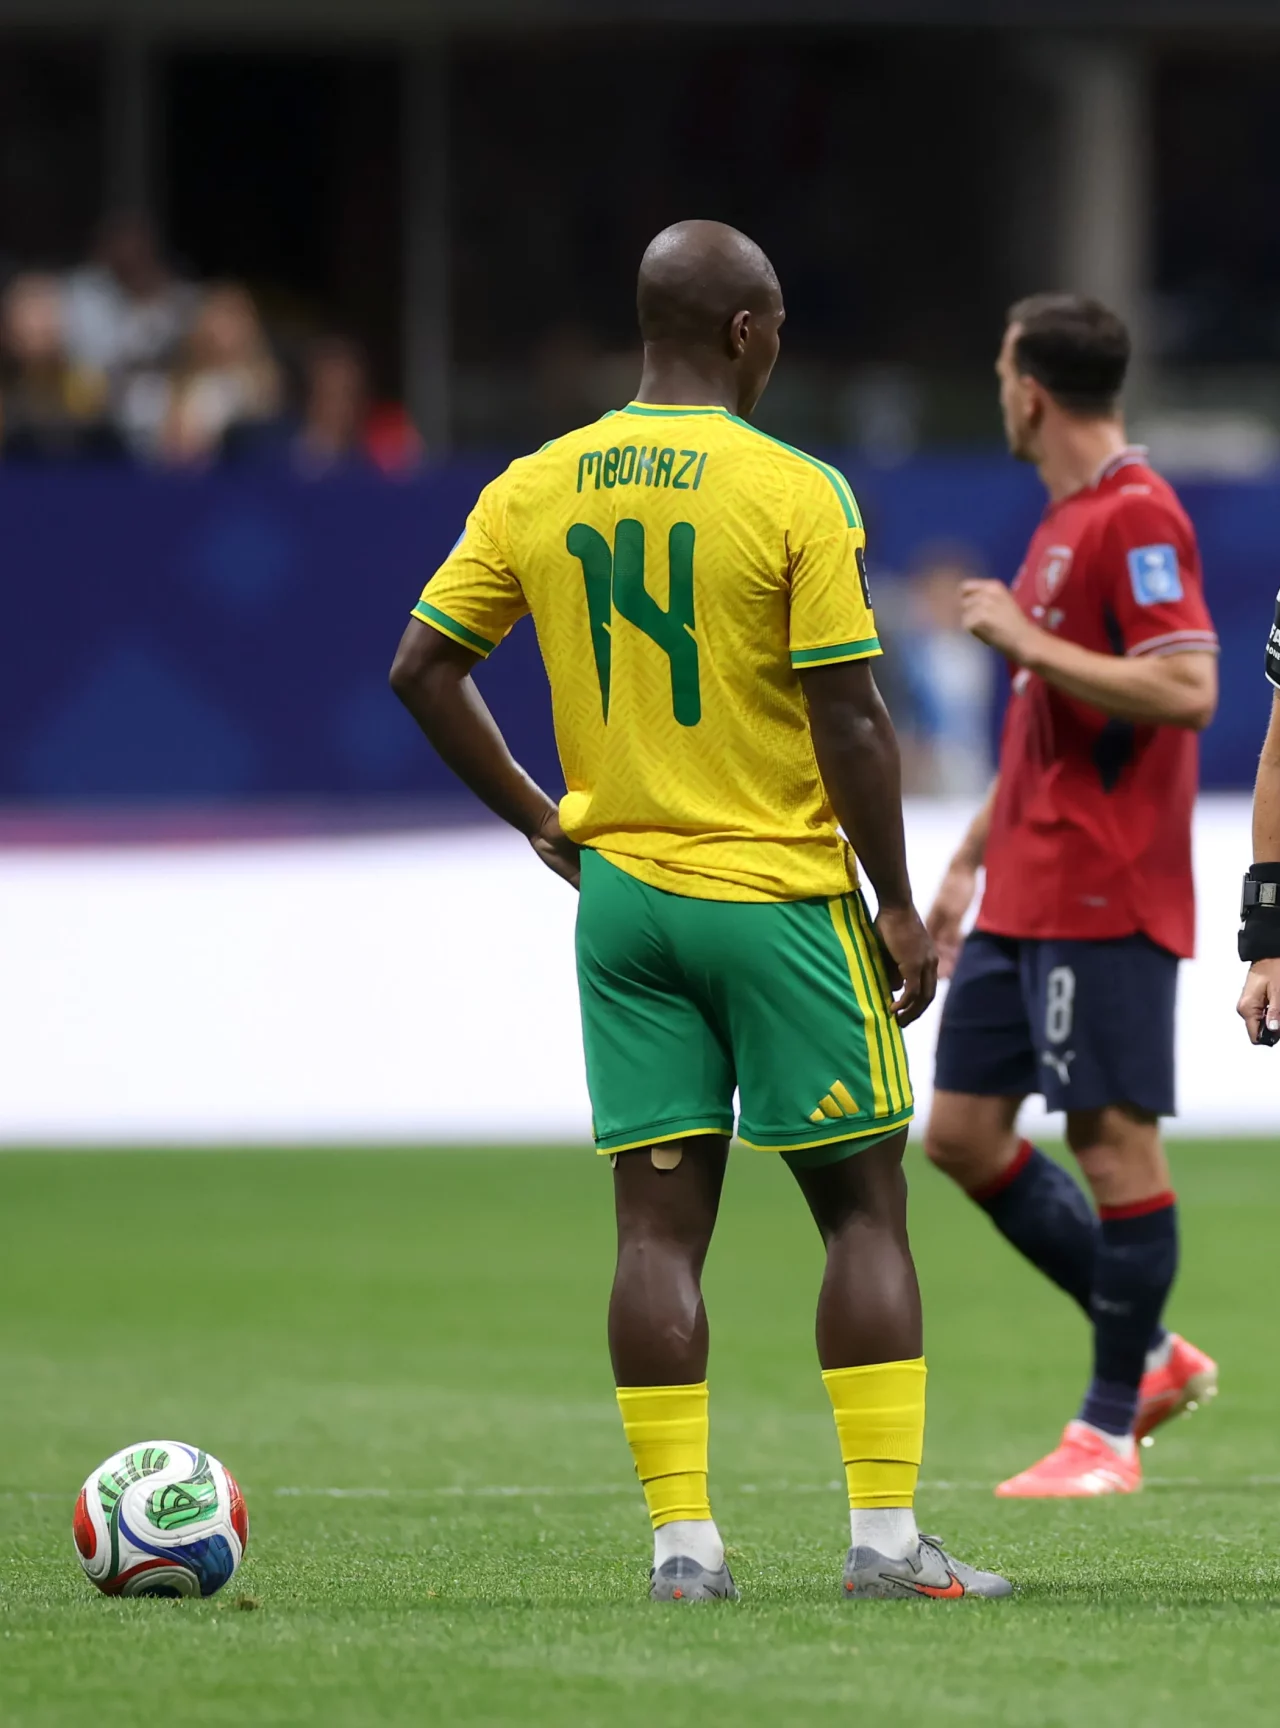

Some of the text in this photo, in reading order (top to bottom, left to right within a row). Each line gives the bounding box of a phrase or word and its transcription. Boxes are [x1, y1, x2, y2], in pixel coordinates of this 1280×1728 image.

[577, 446, 708, 493] MBOKAZI
[565, 518, 701, 727] 14
[1046, 966, 1076, 1044] 8
